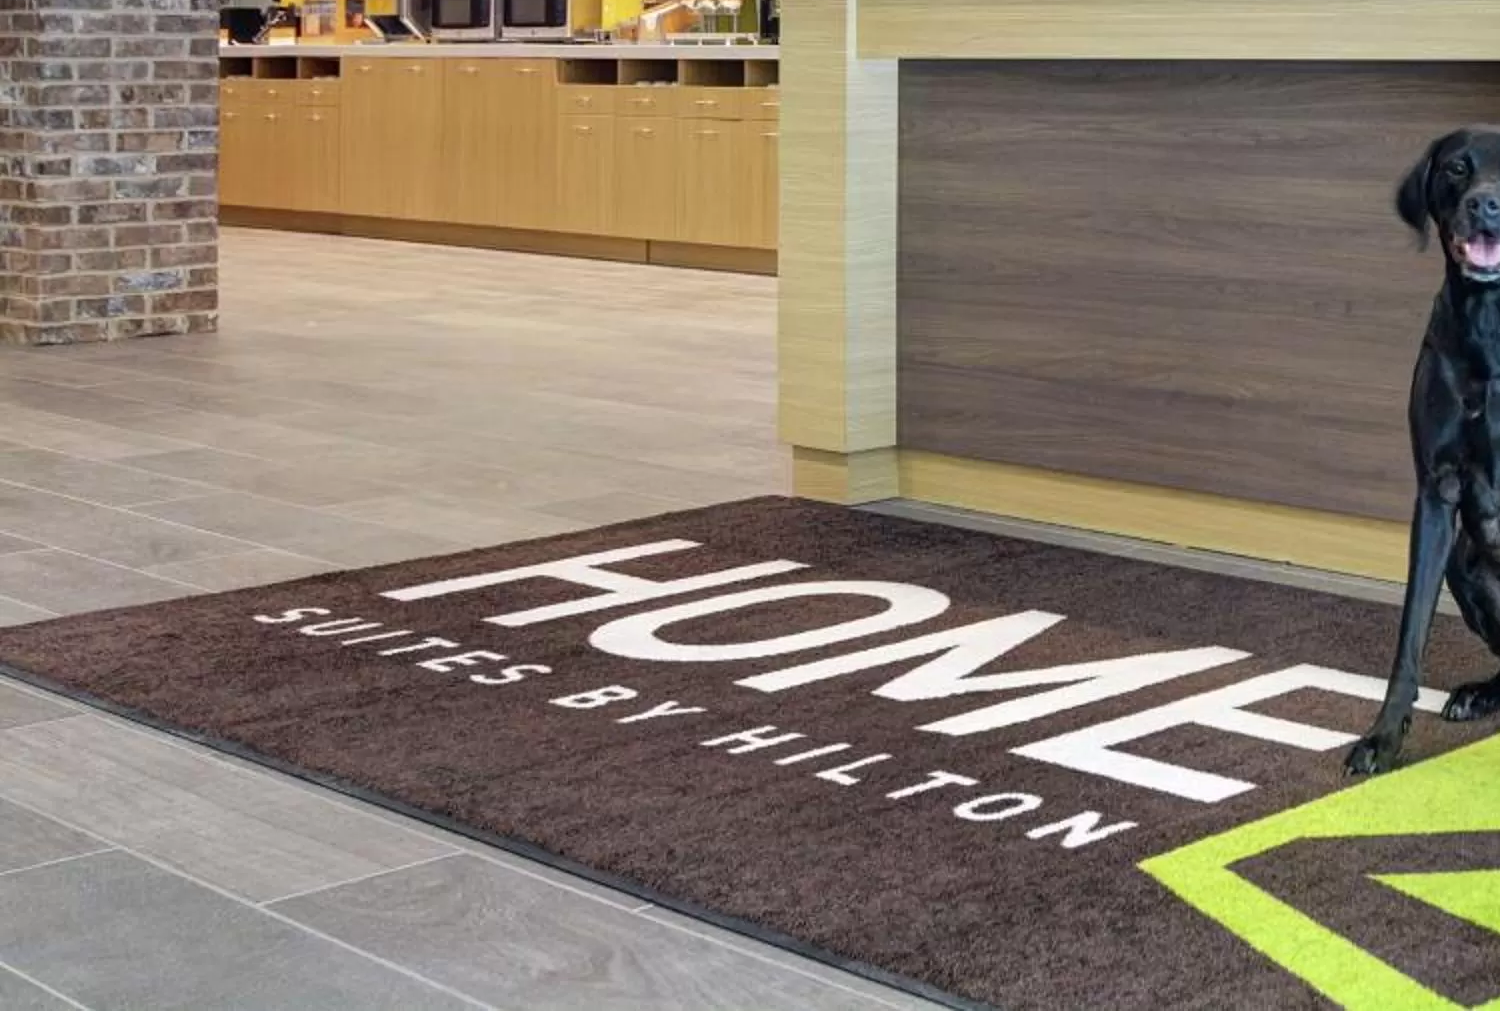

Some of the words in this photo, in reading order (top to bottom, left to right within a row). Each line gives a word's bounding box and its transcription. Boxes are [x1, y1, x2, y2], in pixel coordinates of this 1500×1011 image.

[253, 606, 553, 686] SUITES
[548, 685, 707, 724] BY
[699, 724, 1139, 849] HILTON
